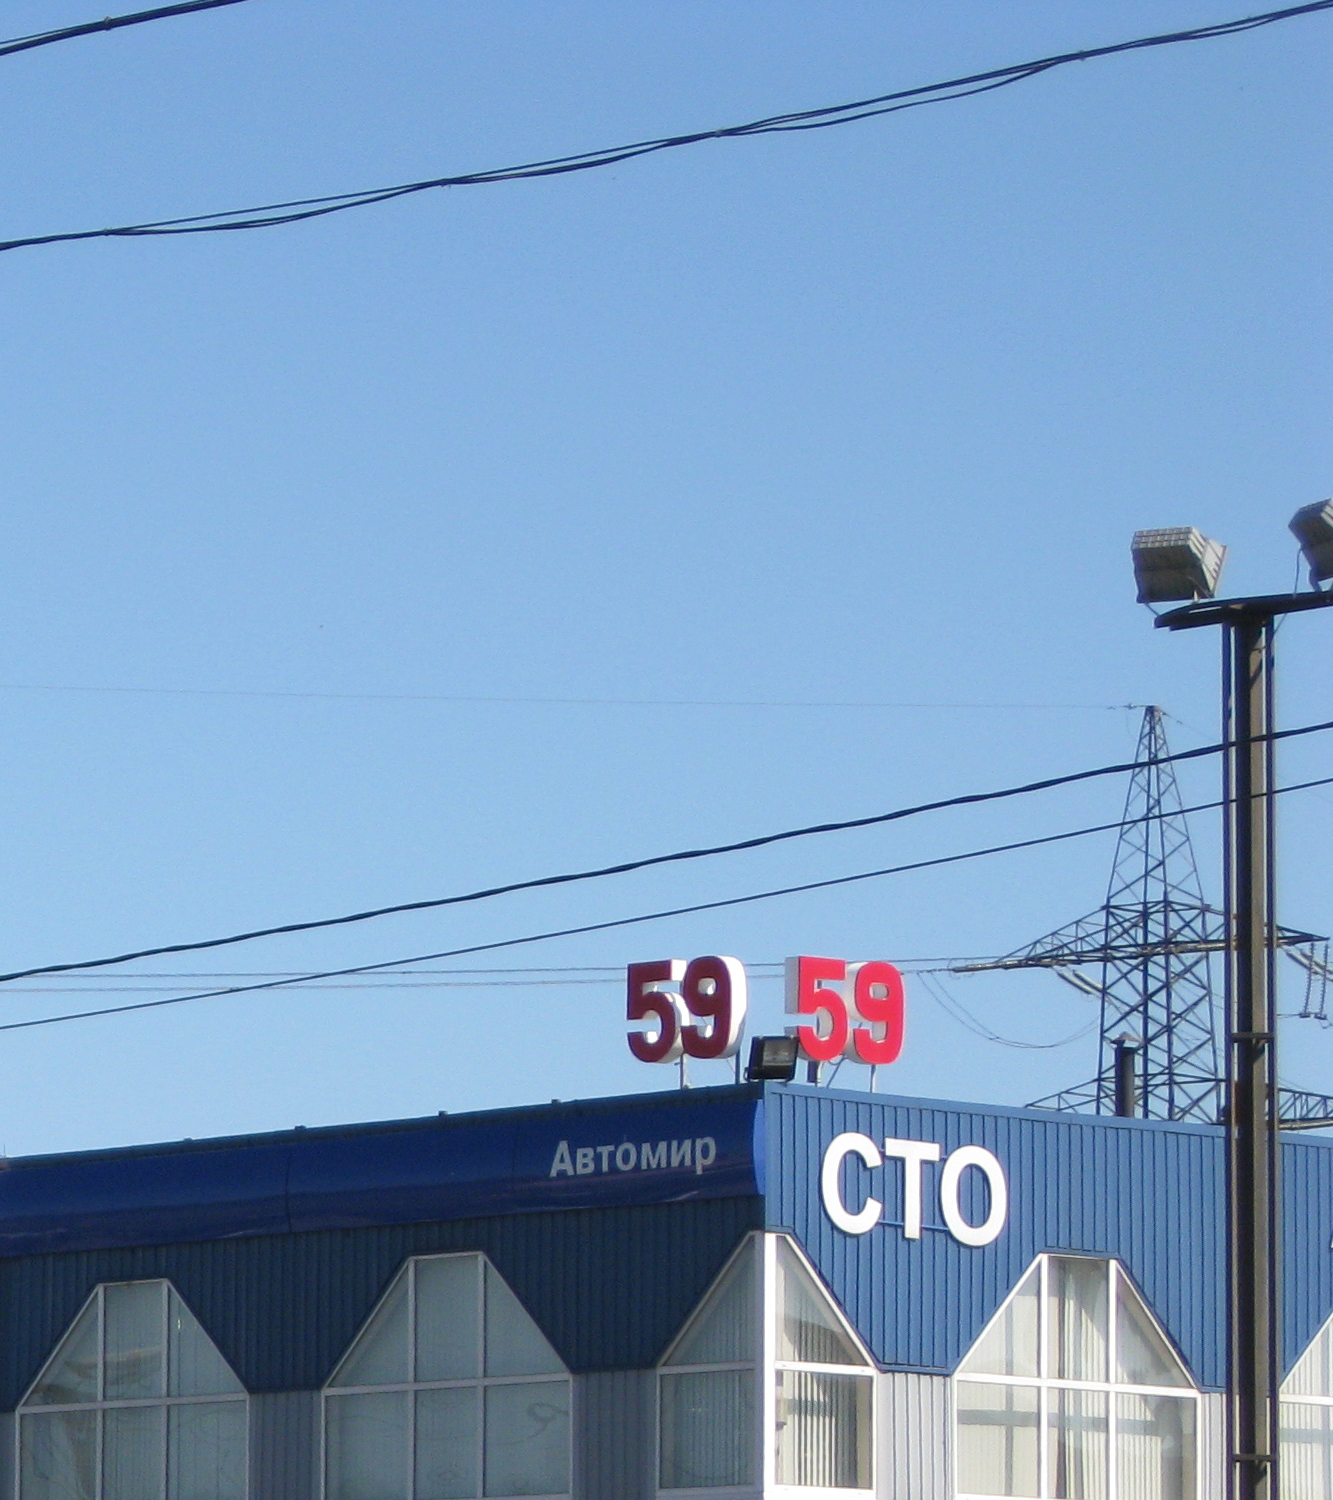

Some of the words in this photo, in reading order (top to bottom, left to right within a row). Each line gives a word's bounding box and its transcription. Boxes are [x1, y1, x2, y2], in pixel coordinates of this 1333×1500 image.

[627, 956, 735, 1064] 59
[793, 956, 905, 1065] 59
[549, 1136, 716, 1177] Автомир
[822, 1132, 1008, 1247] СТО
